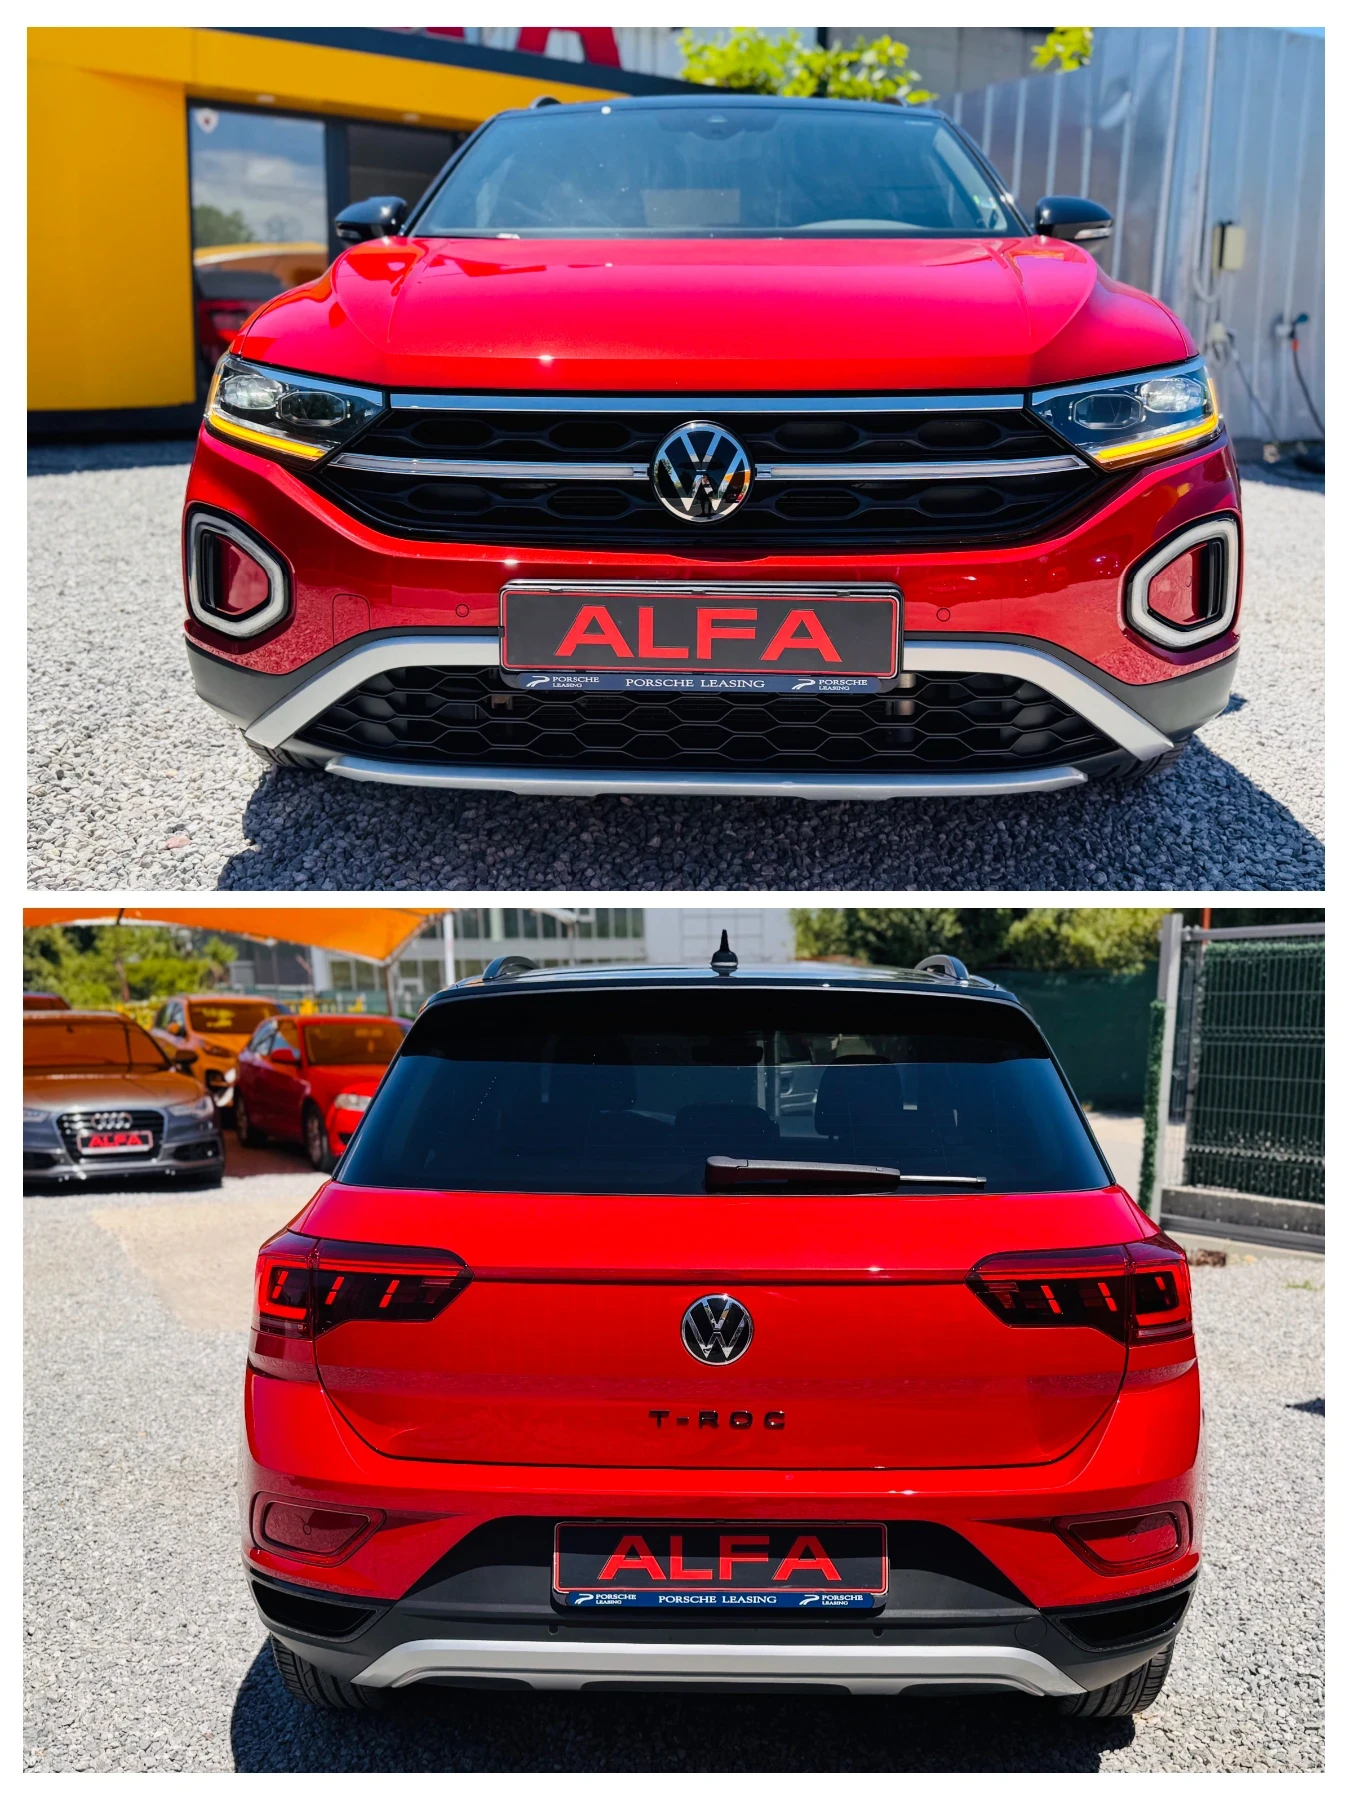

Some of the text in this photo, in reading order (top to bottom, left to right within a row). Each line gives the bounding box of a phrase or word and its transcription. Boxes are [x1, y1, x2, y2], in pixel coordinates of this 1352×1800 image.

[554, 604, 843, 663] ALFA
[625, 678, 766, 688] PORSCHE LEASING
[88, 1134, 143, 1148] ALFA
[648, 1410, 786, 1430] T-ROC
[598, 1535, 842, 1581] ALFA
[658, 1595, 777, 1604] PORSCHE LEASING
